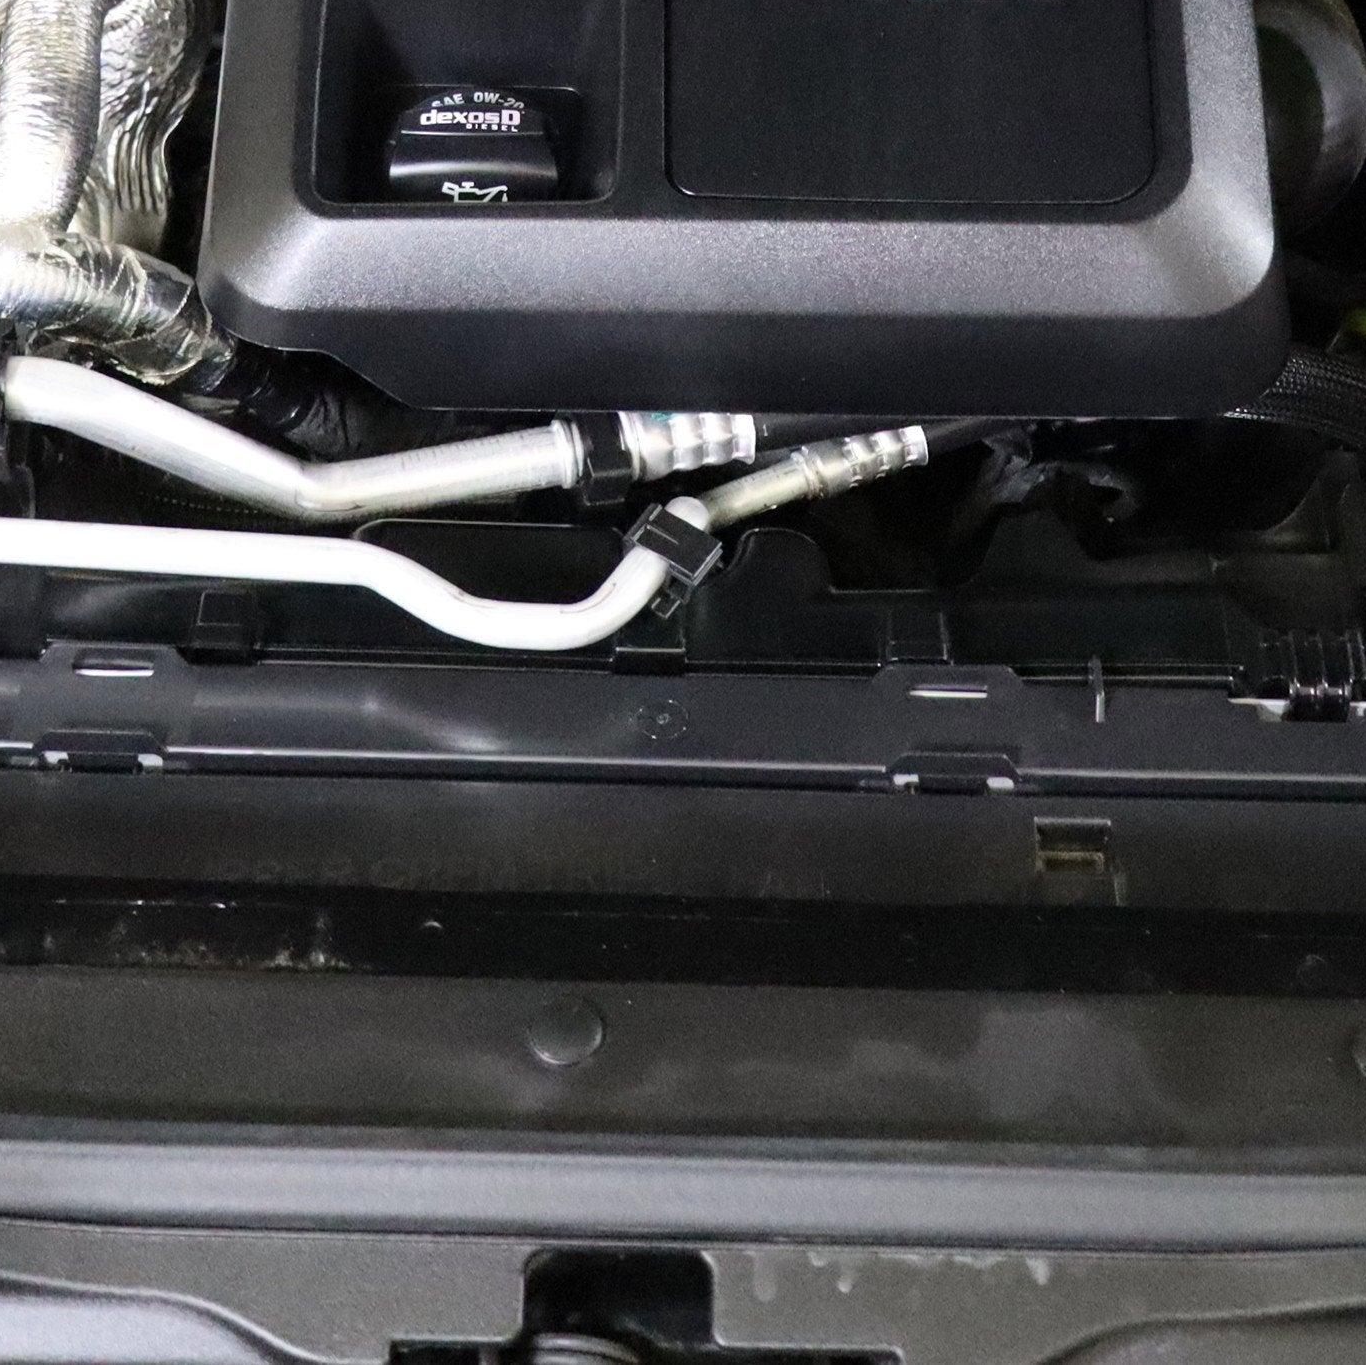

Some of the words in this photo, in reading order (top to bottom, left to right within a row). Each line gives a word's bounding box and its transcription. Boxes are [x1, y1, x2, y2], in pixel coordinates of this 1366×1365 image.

[431, 93, 465, 108] SAE
[473, 91, 525, 109] 0W-20
[466, 123, 518, 132] DIESEL
